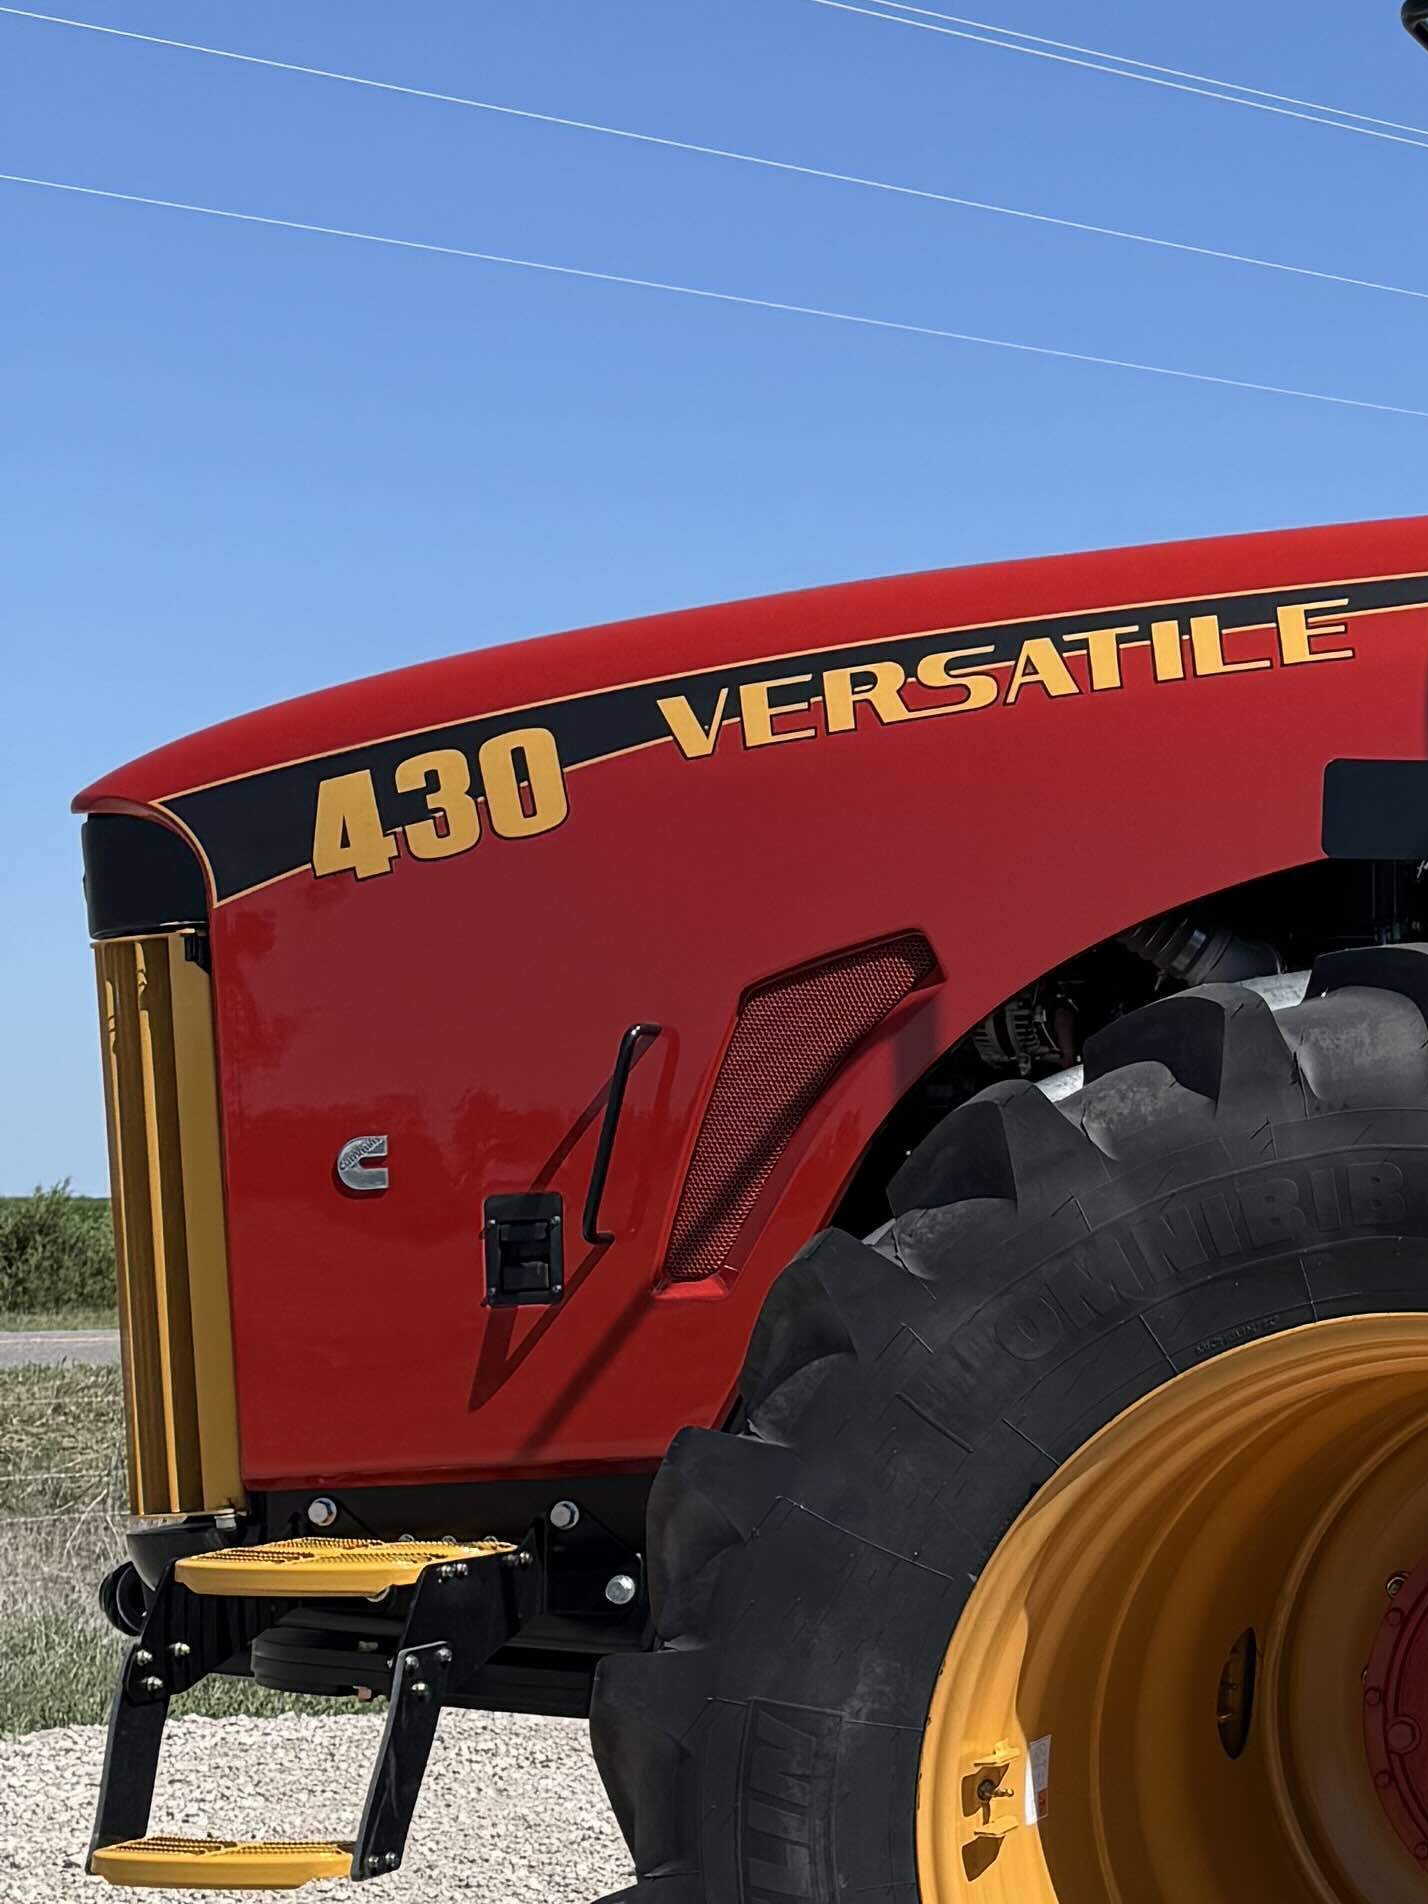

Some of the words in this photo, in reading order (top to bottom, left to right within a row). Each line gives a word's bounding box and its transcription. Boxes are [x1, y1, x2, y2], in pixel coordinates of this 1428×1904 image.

[655, 597, 1356, 761] VERSATILE
[309, 726, 572, 882] 430
[996, 1161, 1406, 1362] OMNIBIB
